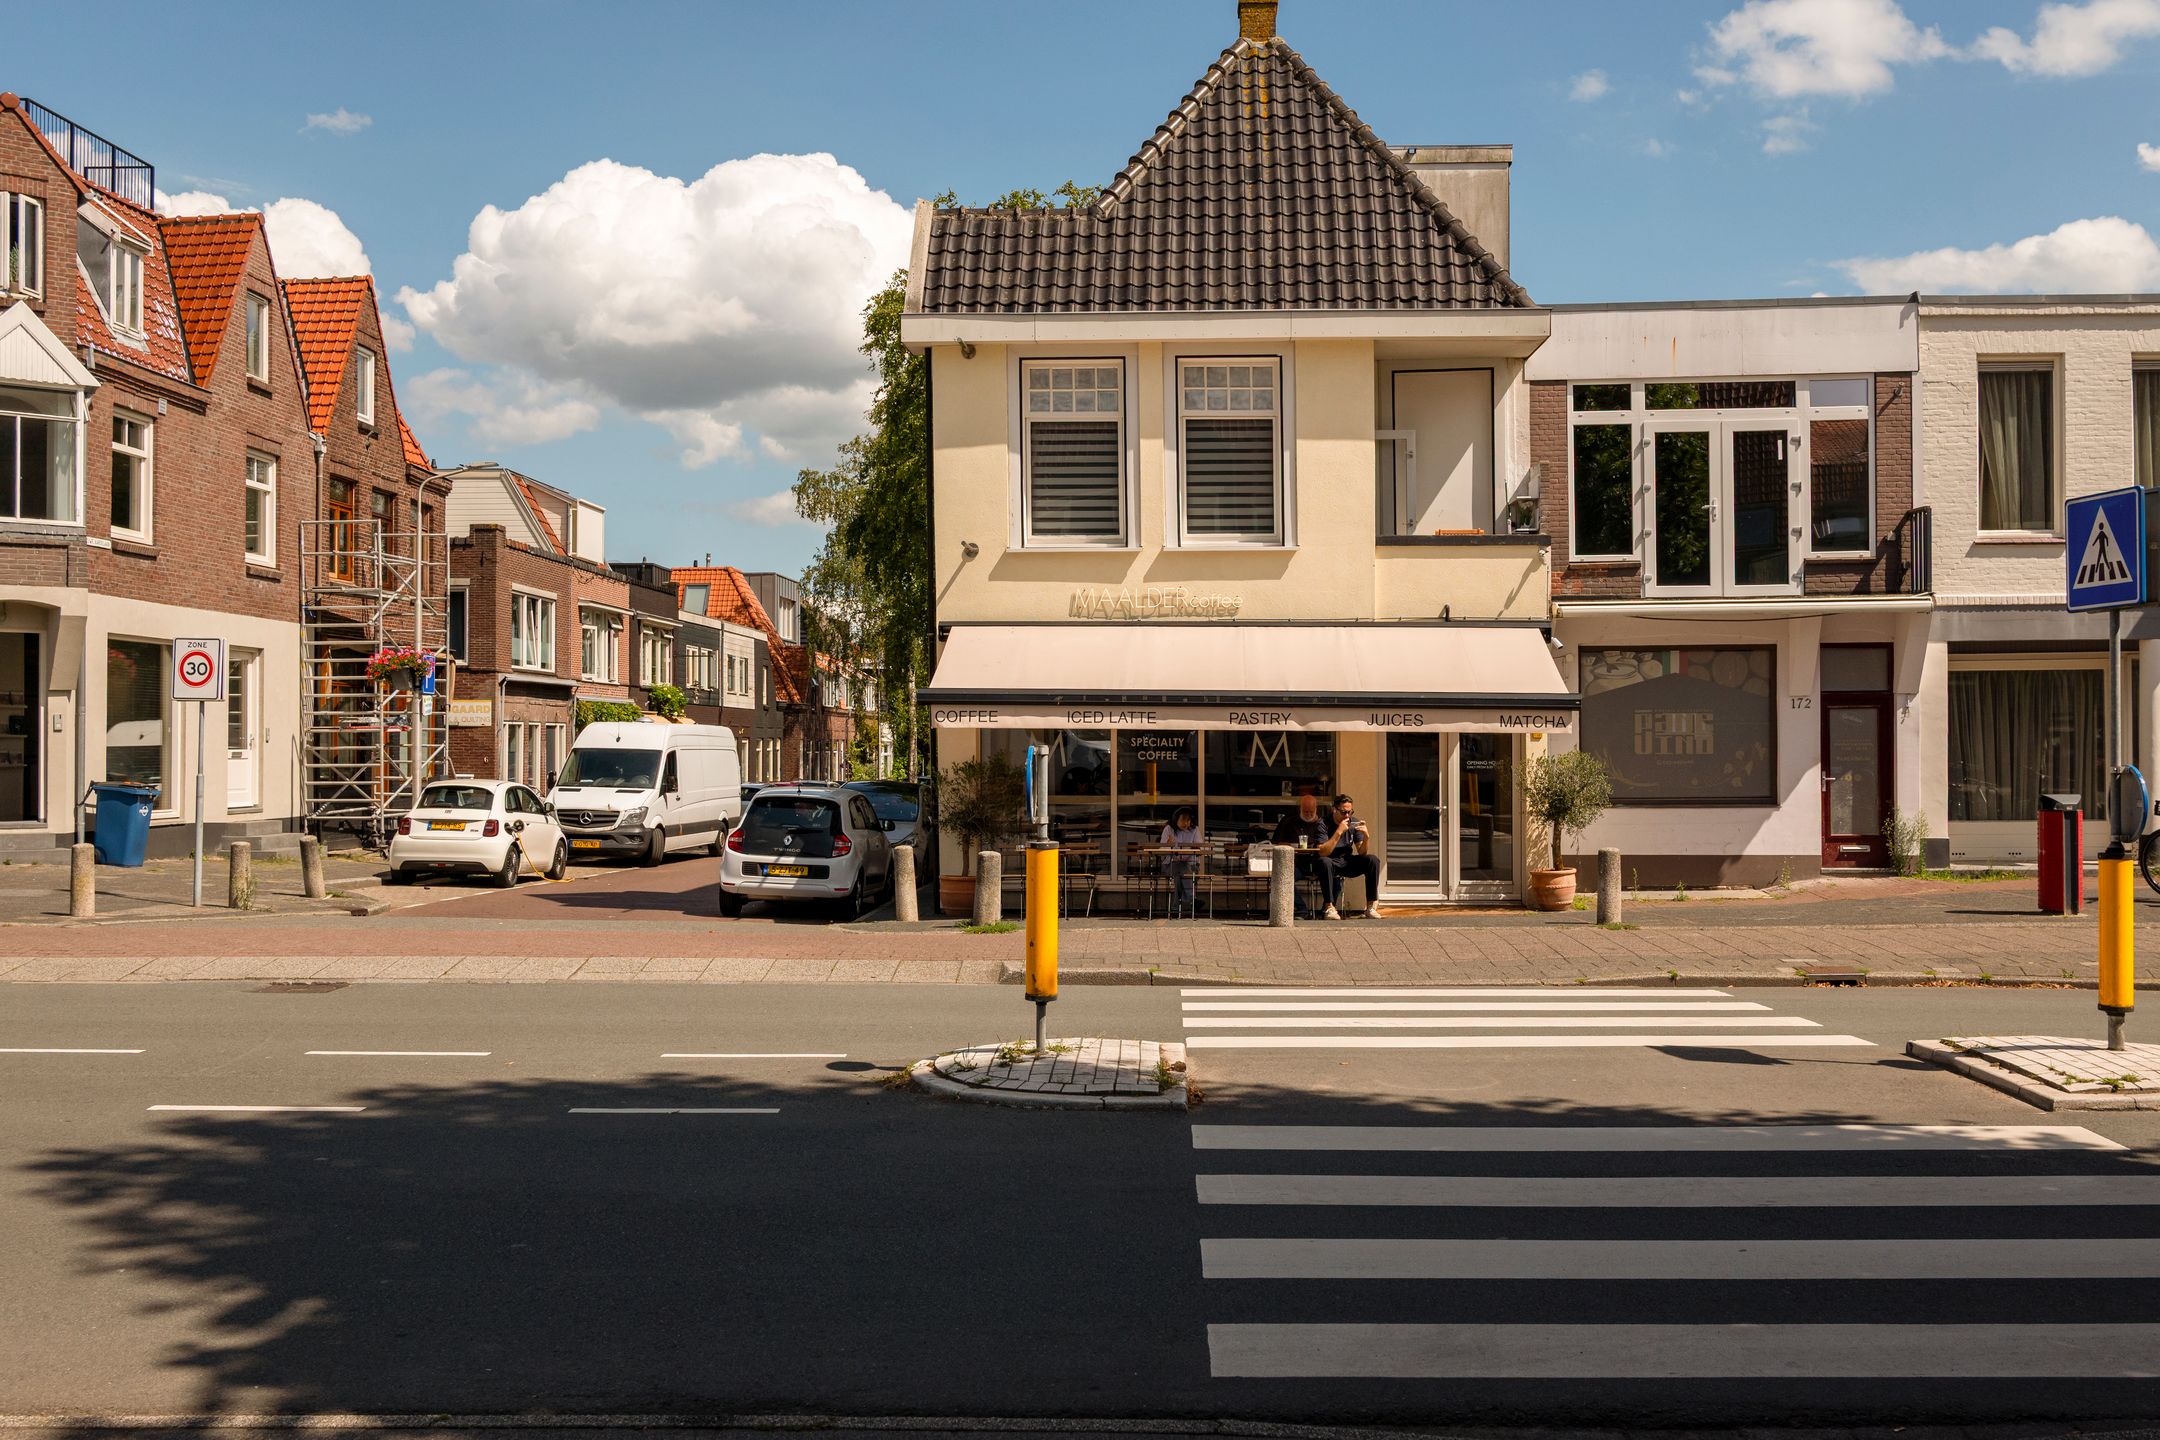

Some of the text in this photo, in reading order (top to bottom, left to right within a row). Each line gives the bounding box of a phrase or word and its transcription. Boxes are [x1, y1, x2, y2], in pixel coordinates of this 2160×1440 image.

[187, 641, 208, 649] ZONE
[186, 661, 208, 676] 30
[451, 705, 491, 714] GAARD
[1791, 697, 1812, 709] 172
[934, 710, 999, 723] COFFEE
[1066, 710, 1157, 724] ICED LATTE
[1229, 712, 1292, 725] PASTRY
[1366, 713, 1424, 727] JUICES
[1499, 715, 1567, 729] MATCHA
[1130, 737, 1185, 748] SPECIALTY
[1137, 750, 1178, 761] COFFEE
[1249, 731, 1291, 768] M
